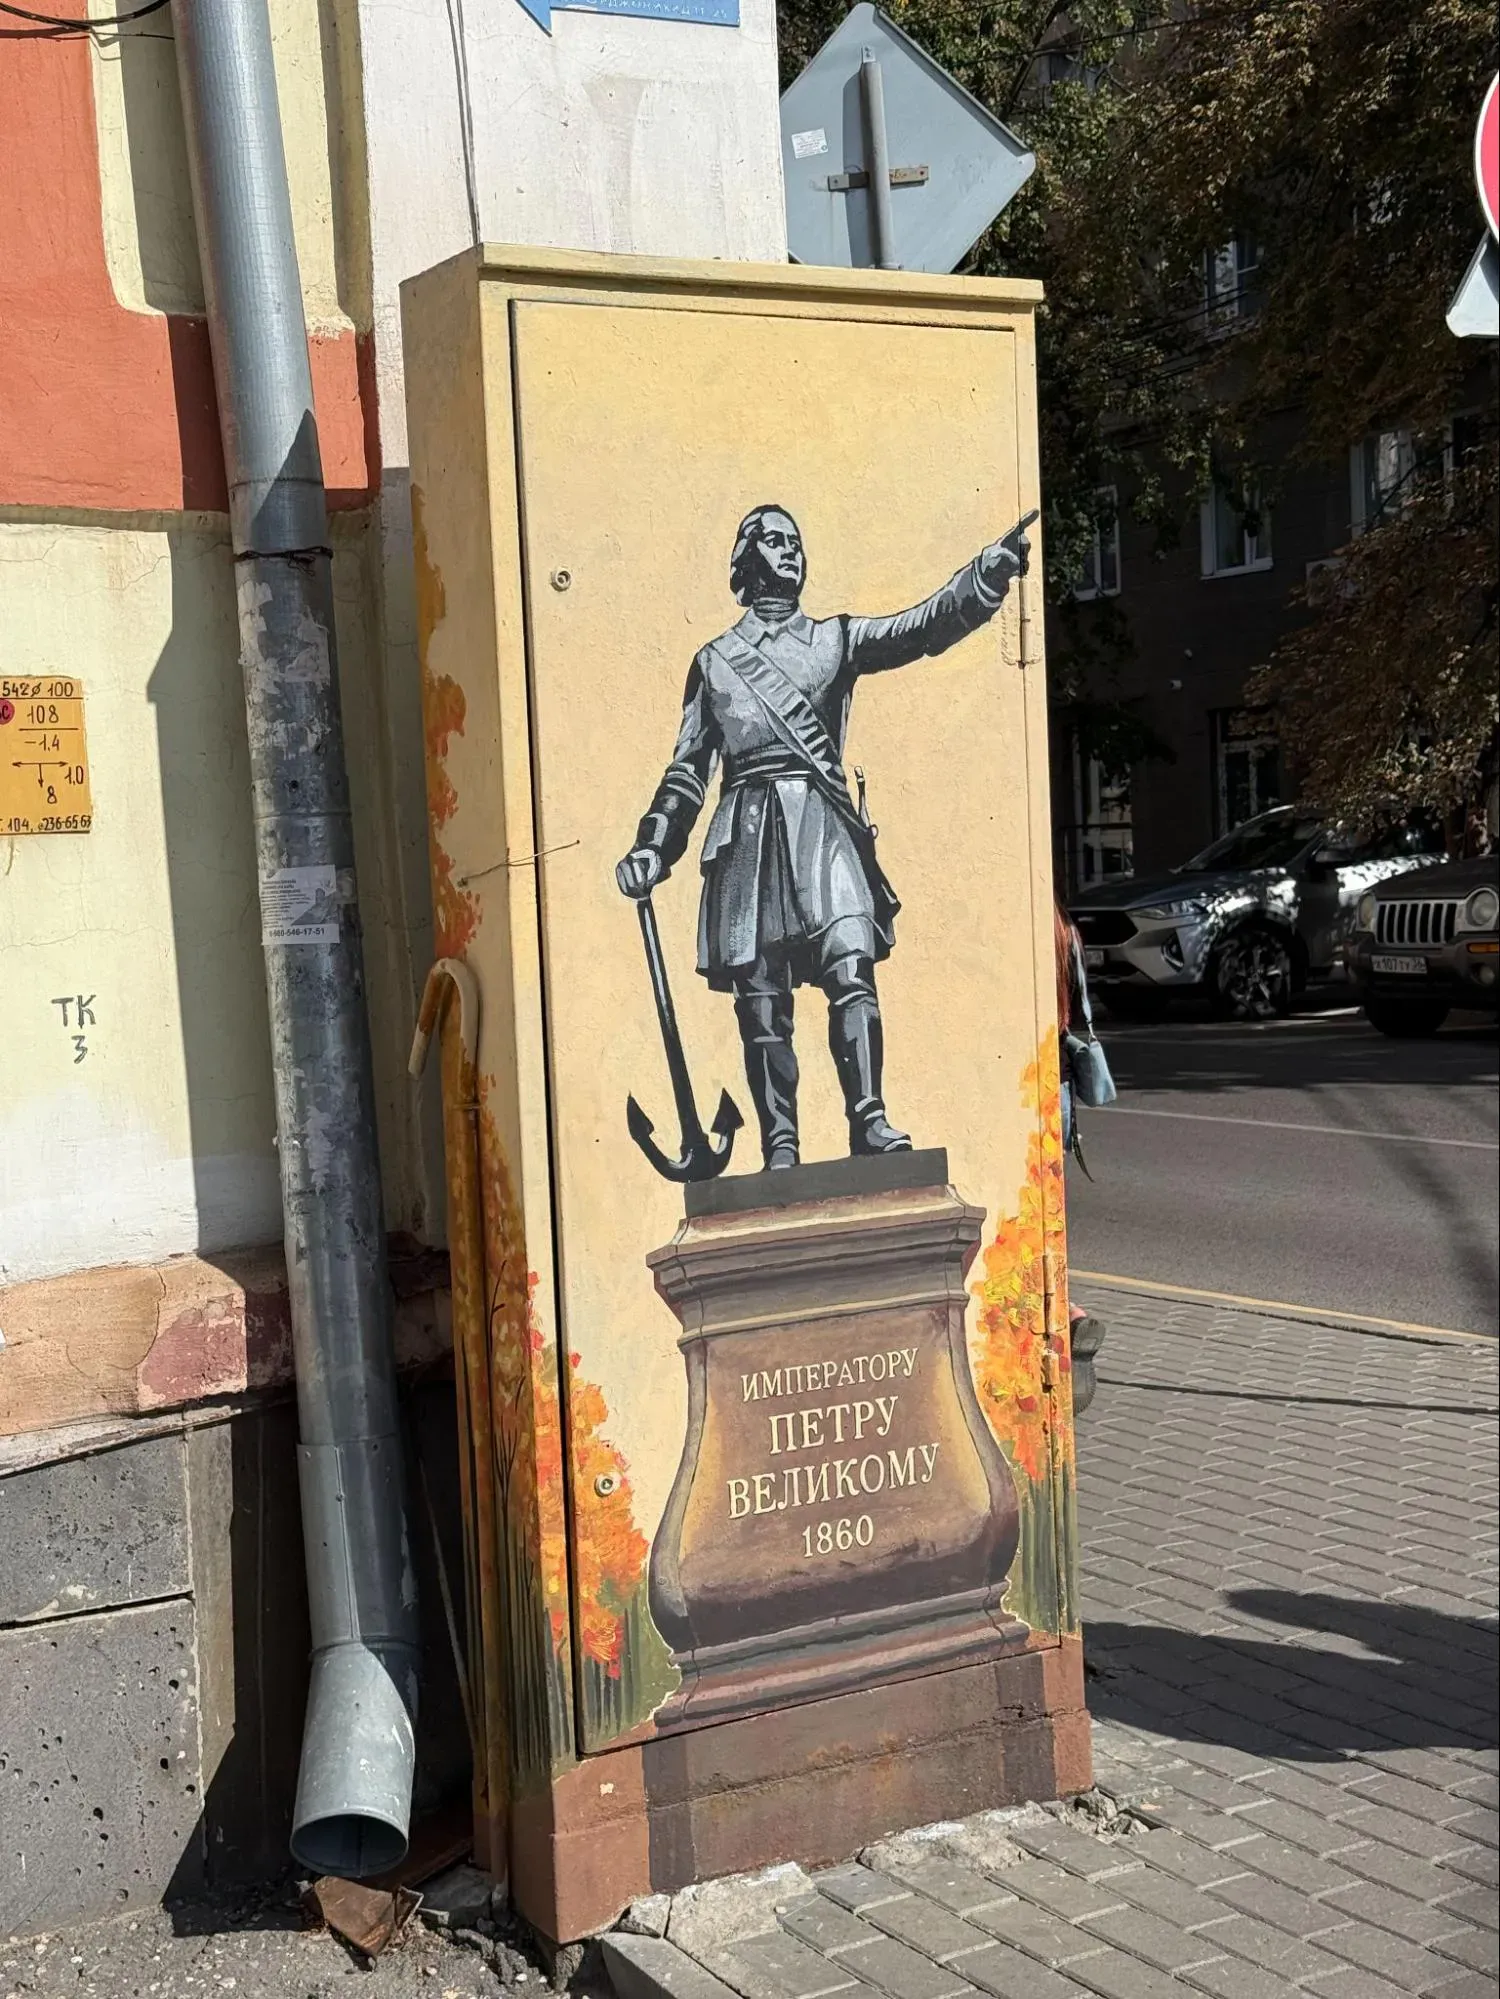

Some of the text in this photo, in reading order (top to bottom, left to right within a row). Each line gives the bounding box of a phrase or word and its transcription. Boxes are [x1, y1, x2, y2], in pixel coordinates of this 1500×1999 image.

[47, 682, 74, 697] 100
[27, 704, 60, 724] 108
[46, 786, 58, 804] 8
[51, 994, 97, 1029] ТК
[71, 1035, 88, 1064] 3
[740, 1347, 919, 1403] ИМПЕРАТОРУ
[768, 1395, 899, 1455] ПЕТРУ
[726, 1442, 940, 1520] ВЕЛИКОМУ
[801, 1514, 875, 1558] 1860
